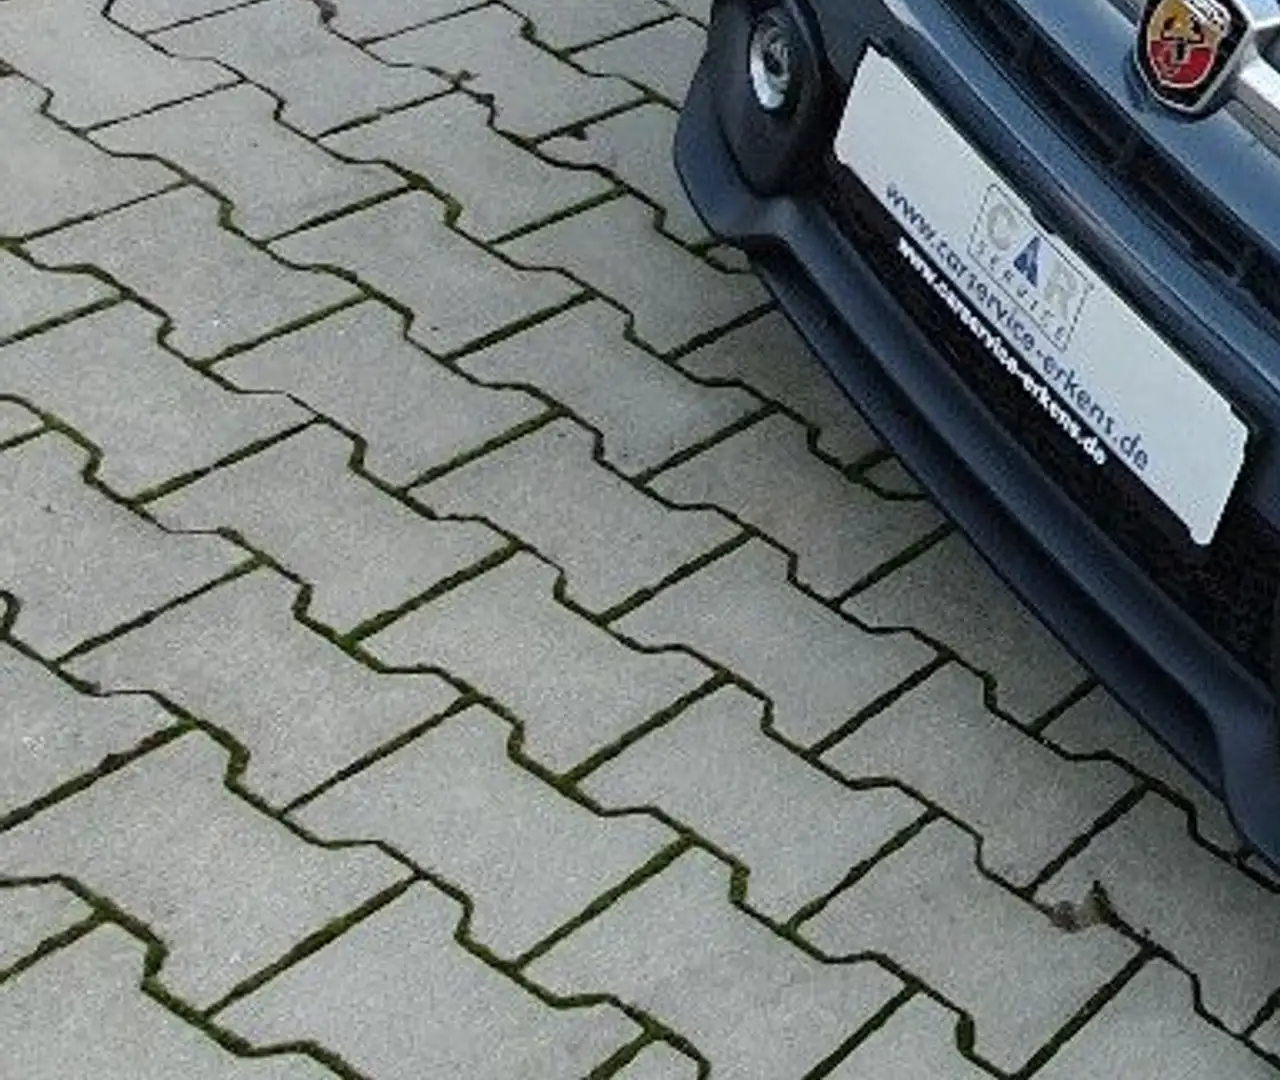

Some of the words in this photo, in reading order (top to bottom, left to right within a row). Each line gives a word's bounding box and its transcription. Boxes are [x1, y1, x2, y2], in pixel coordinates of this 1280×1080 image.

[886, 183, 1149, 470] www.carservice-erkens.de
[898, 236, 1107, 465] www.carservice-erkens.de
[986, 203, 1077, 313] CAR
